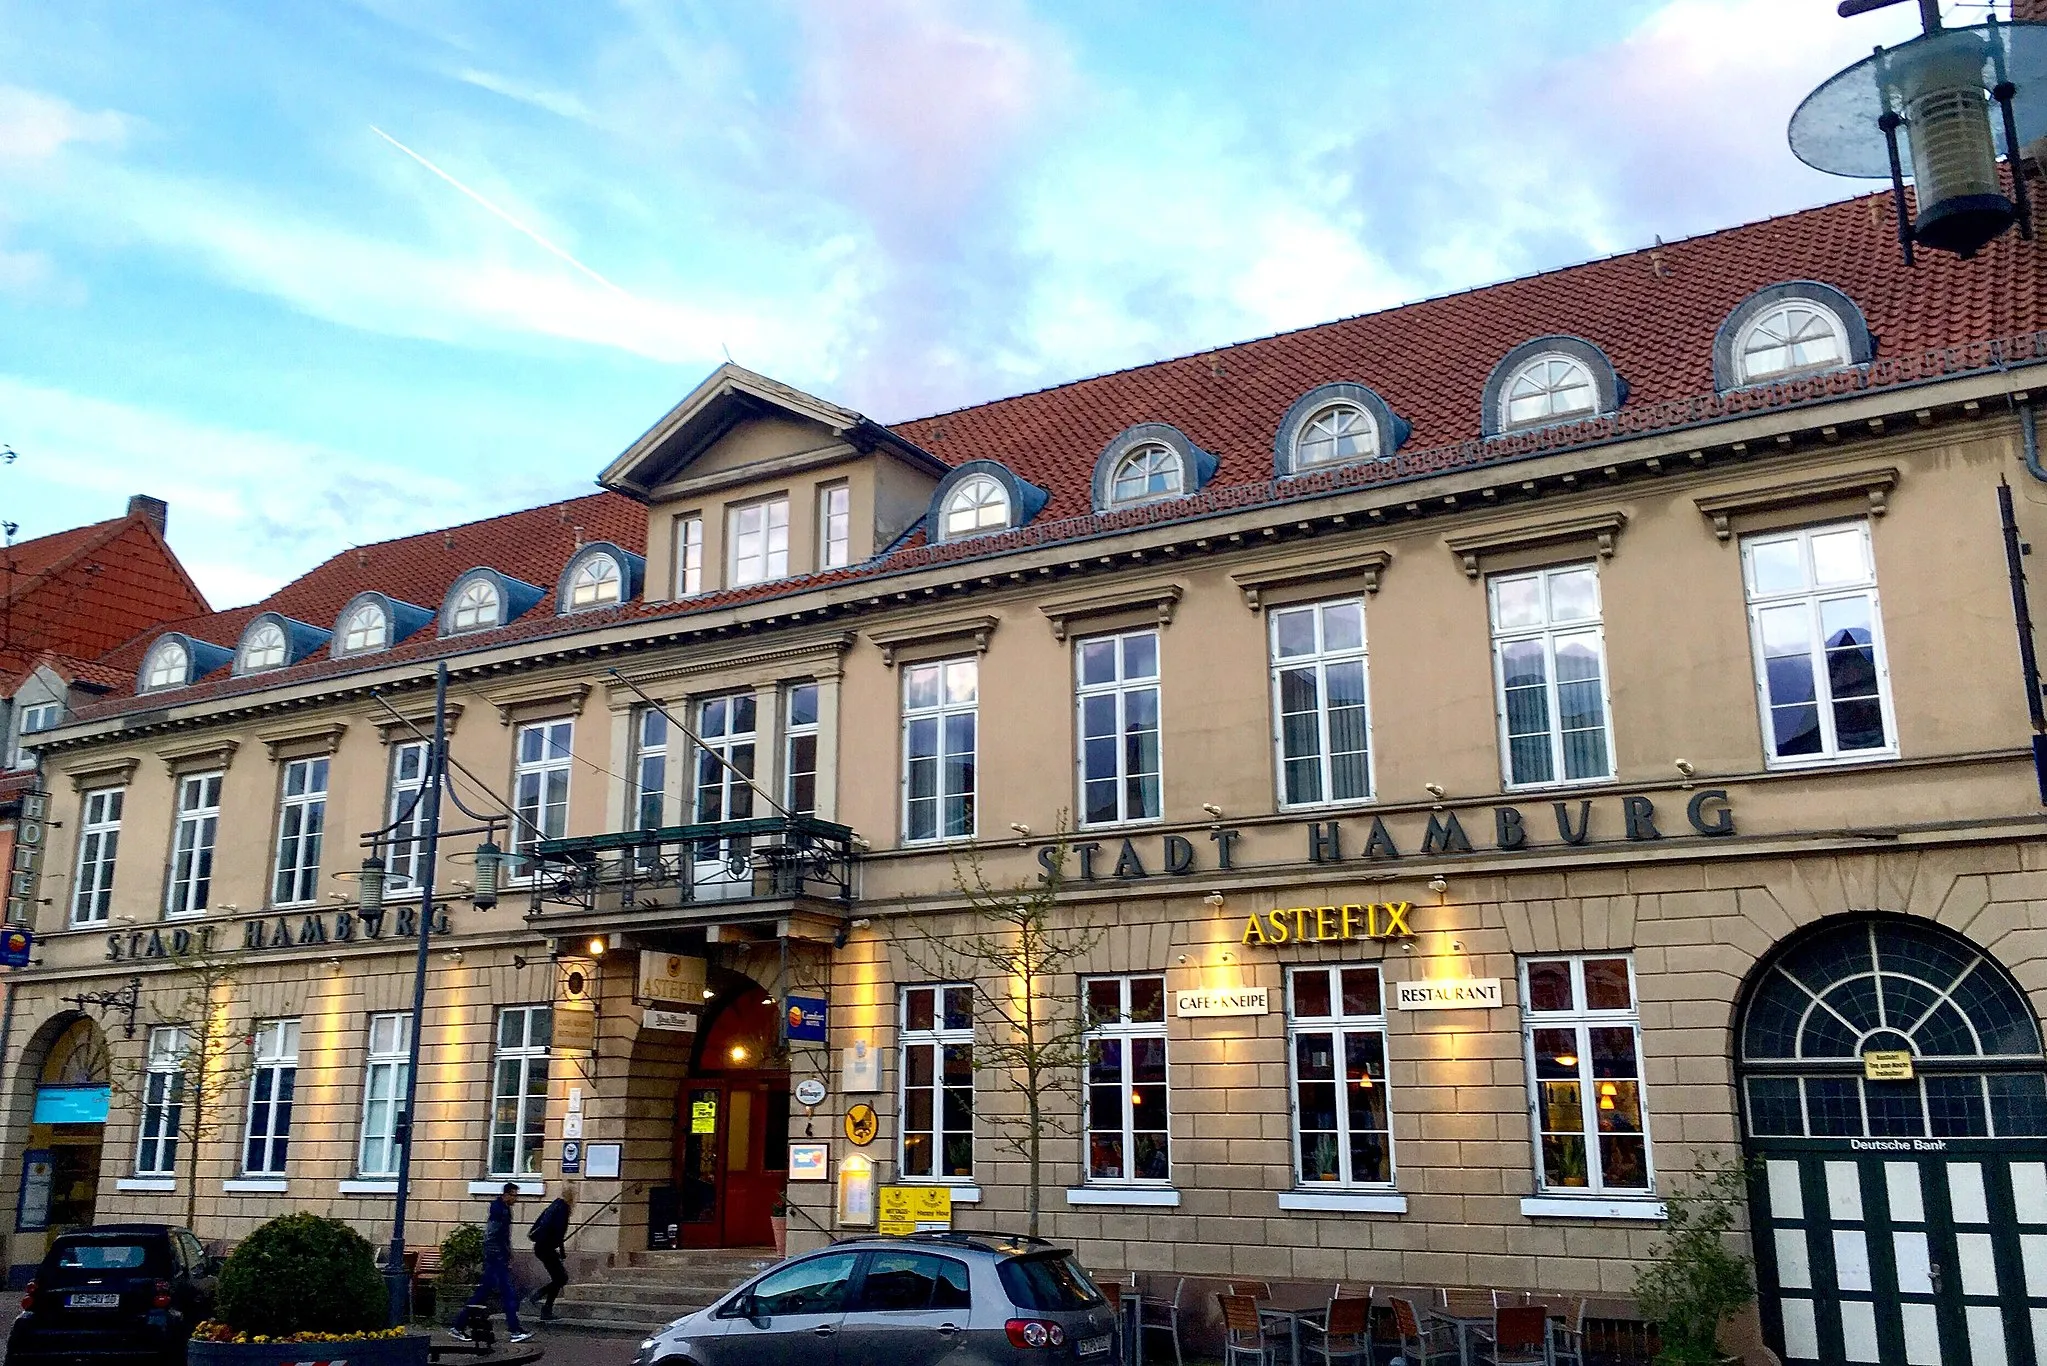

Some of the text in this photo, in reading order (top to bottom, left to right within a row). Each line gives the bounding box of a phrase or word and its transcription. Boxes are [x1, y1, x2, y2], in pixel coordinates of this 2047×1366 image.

[1037, 789, 1736, 883] STADT HAMBURG
[15, 798, 44, 923] HOTEL
[105, 903, 451, 960] STADT HAMBURG
[1241, 901, 1416, 945] ASTEFIX
[1221, 995, 1266, 1008] KNEIPE
[1401, 986, 1496, 1002] RESTAURANT
[1850, 1139, 1947, 1150] Deutsche Bank
